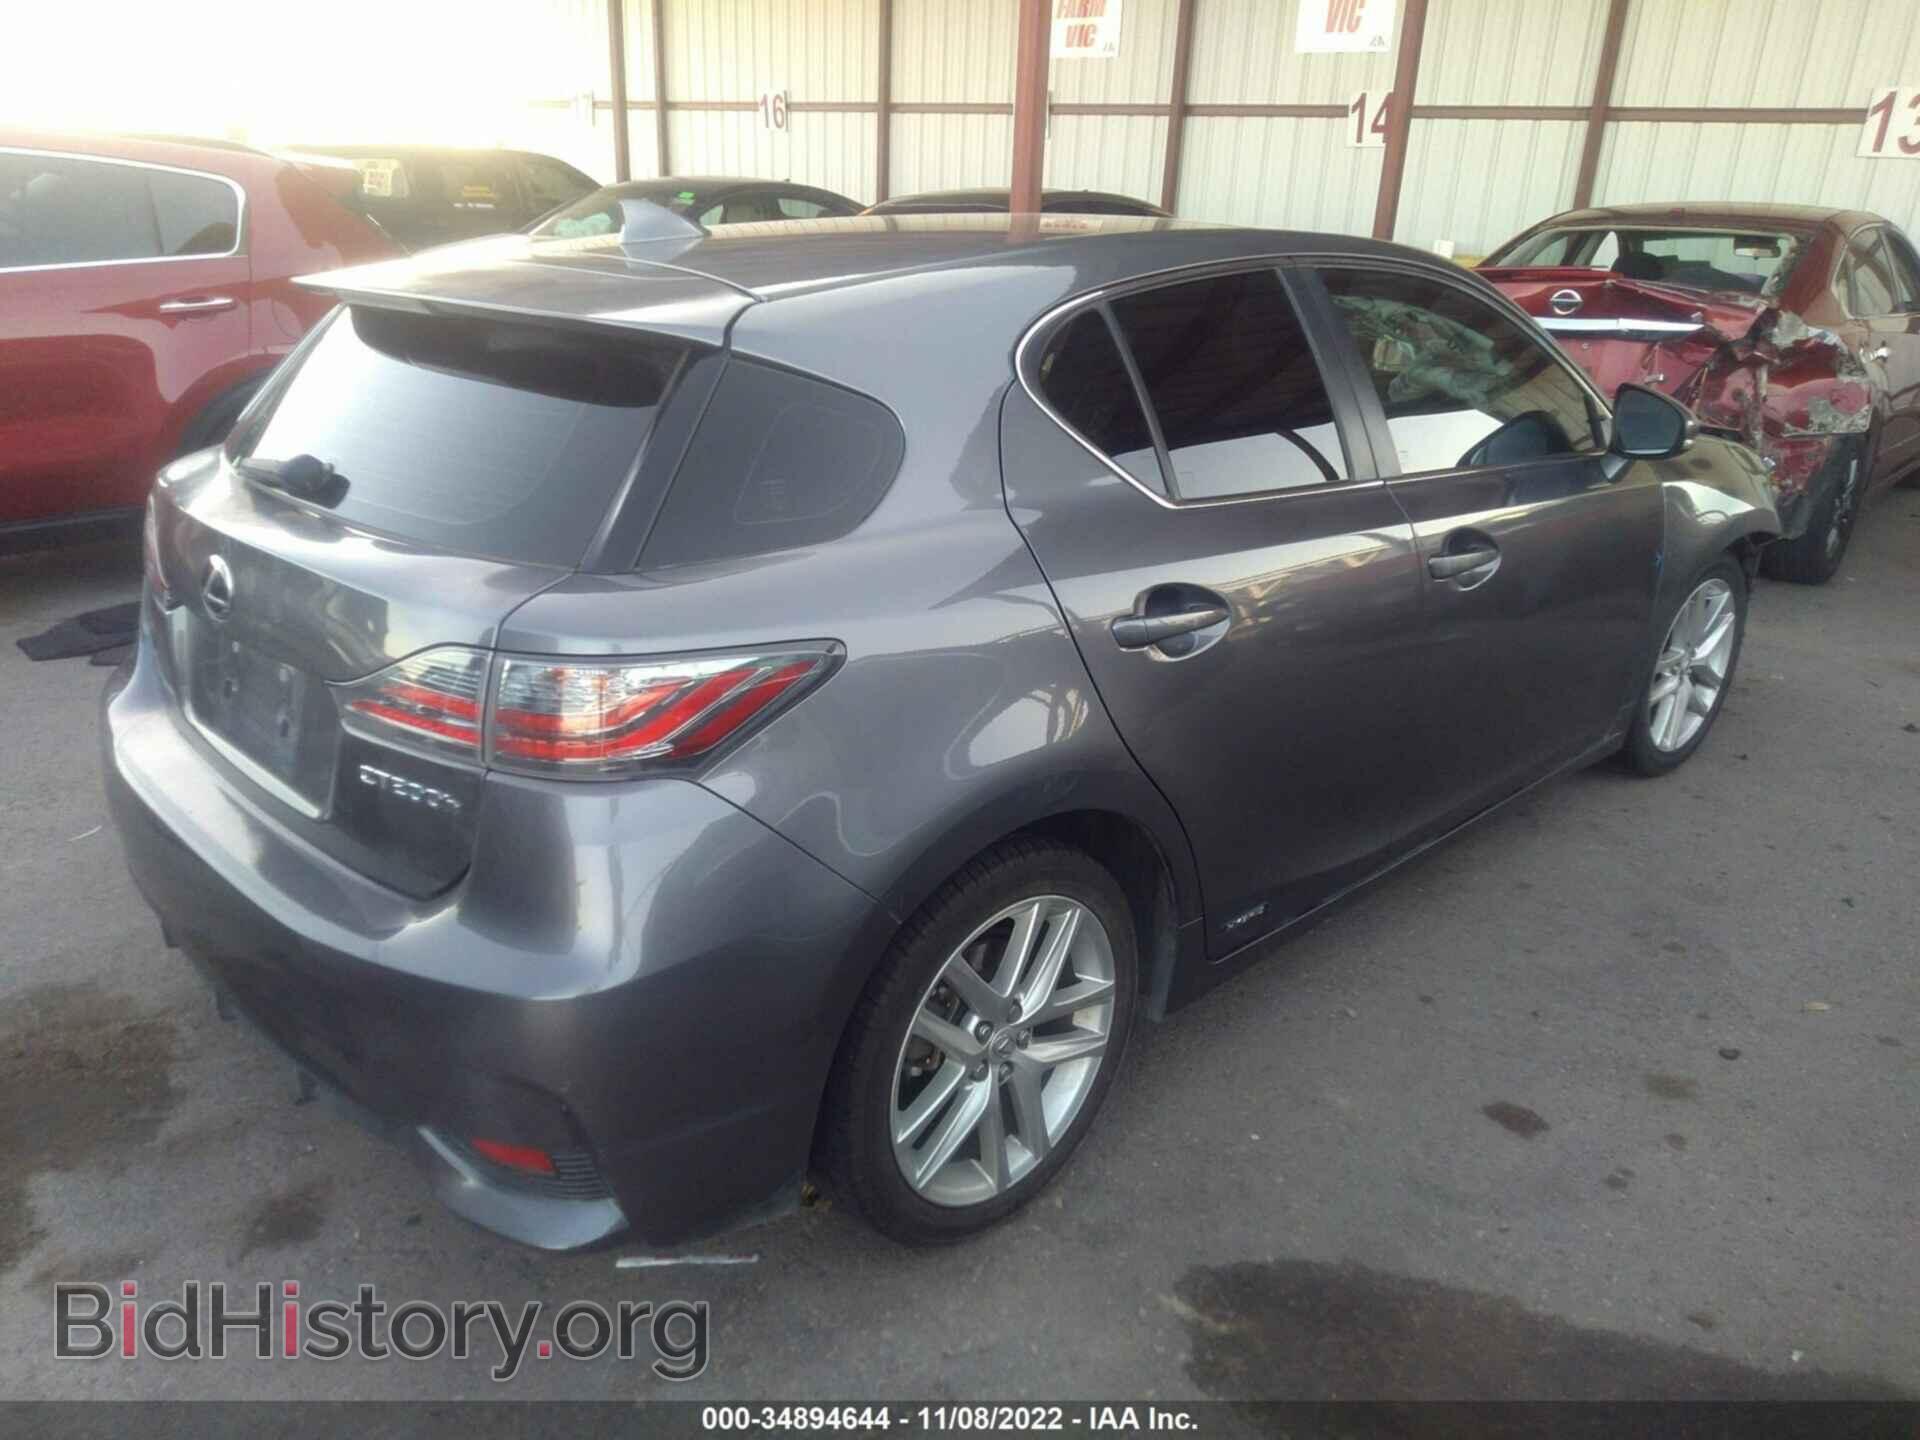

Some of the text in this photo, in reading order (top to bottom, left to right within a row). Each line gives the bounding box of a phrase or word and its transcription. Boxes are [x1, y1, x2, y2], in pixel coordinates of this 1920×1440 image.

[1327, 0, 1366, 33] VIC
[1065, 23, 1098, 48] VIC
[760, 93, 785, 129] 16
[1351, 91, 1394, 144] 14
